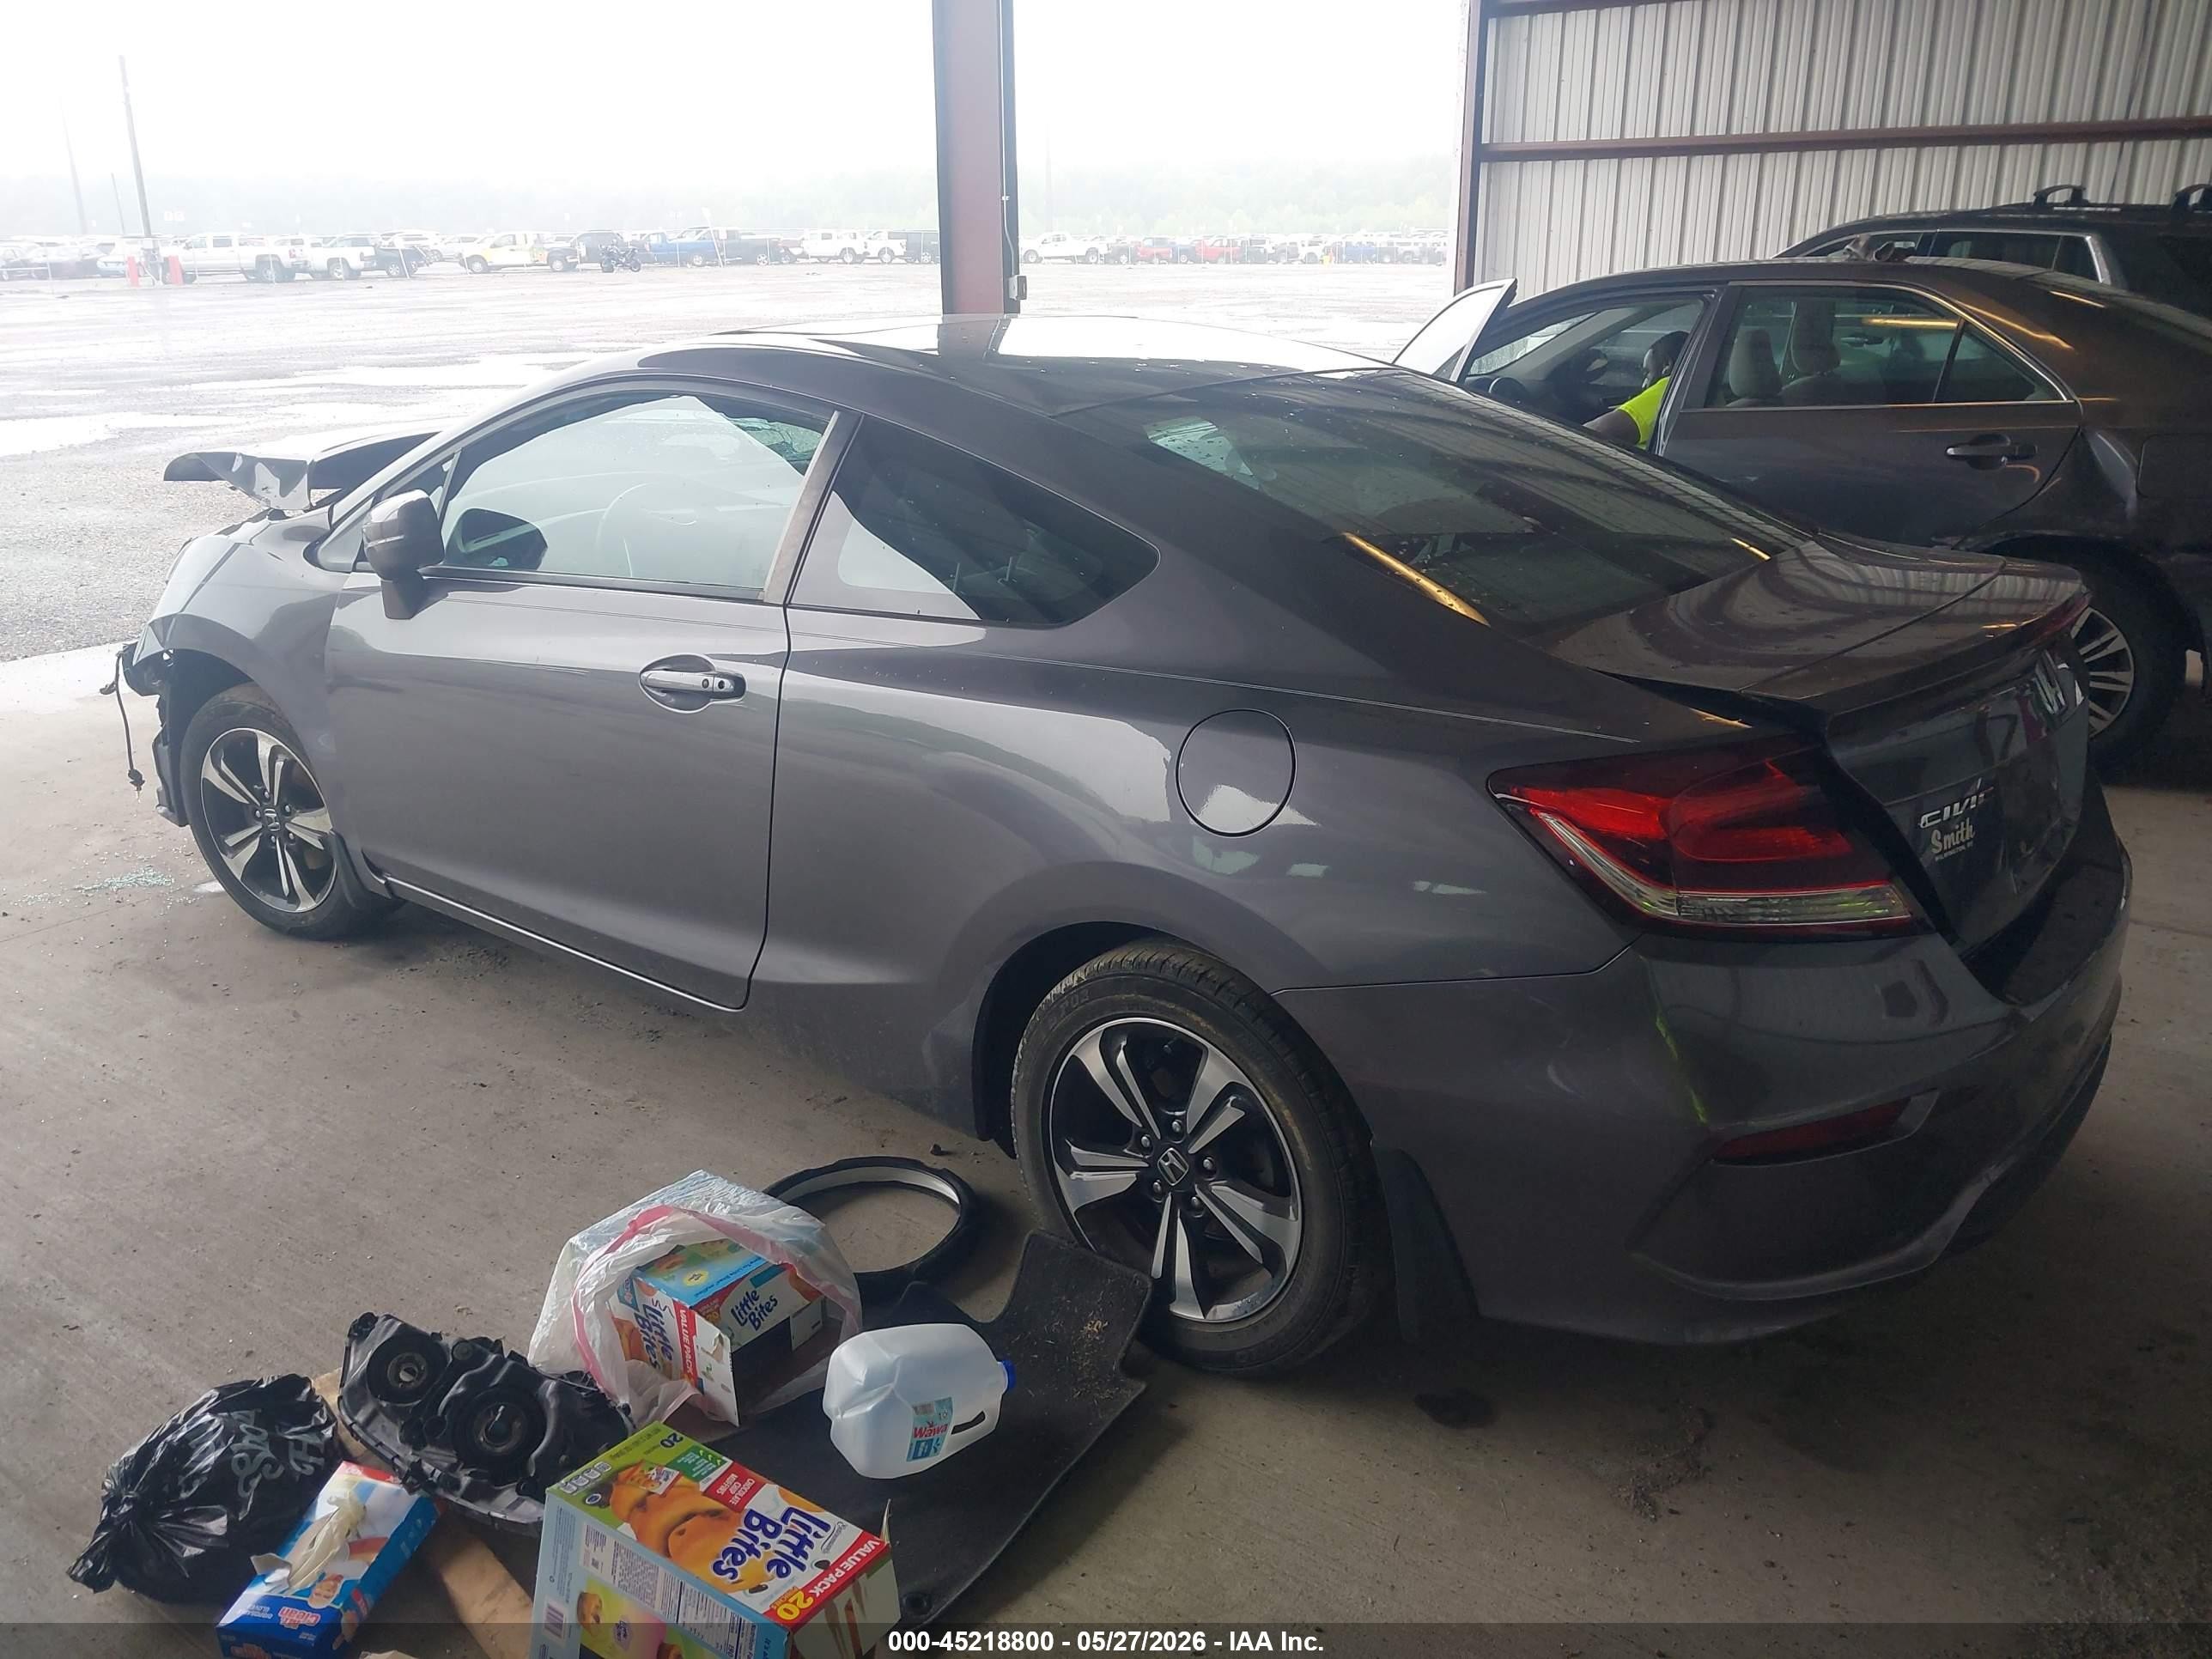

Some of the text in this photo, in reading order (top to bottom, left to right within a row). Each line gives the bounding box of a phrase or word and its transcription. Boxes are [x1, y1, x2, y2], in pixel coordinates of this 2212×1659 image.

[1930, 817, 1976, 854] Smith
[731, 1289, 761, 1327] Little
[747, 1293, 779, 1332] Bites
[634, 1311, 662, 1371] Bites
[642, 1303, 675, 1362] Little
[679, 1308, 696, 1376] VALUE PACK
[659, 1431, 684, 1449] 20
[913, 1422, 949, 1439] Wawa
[716, 1473, 738, 1496] MUFFINS
[728, 1480, 742, 1495] CHIP
[729, 1478, 756, 1505] CHOCOLATE
[712, 1508, 783, 1580] Bites
[766, 1506, 832, 1579] Little
[776, 1540, 881, 1620] VALUE PACK 20
